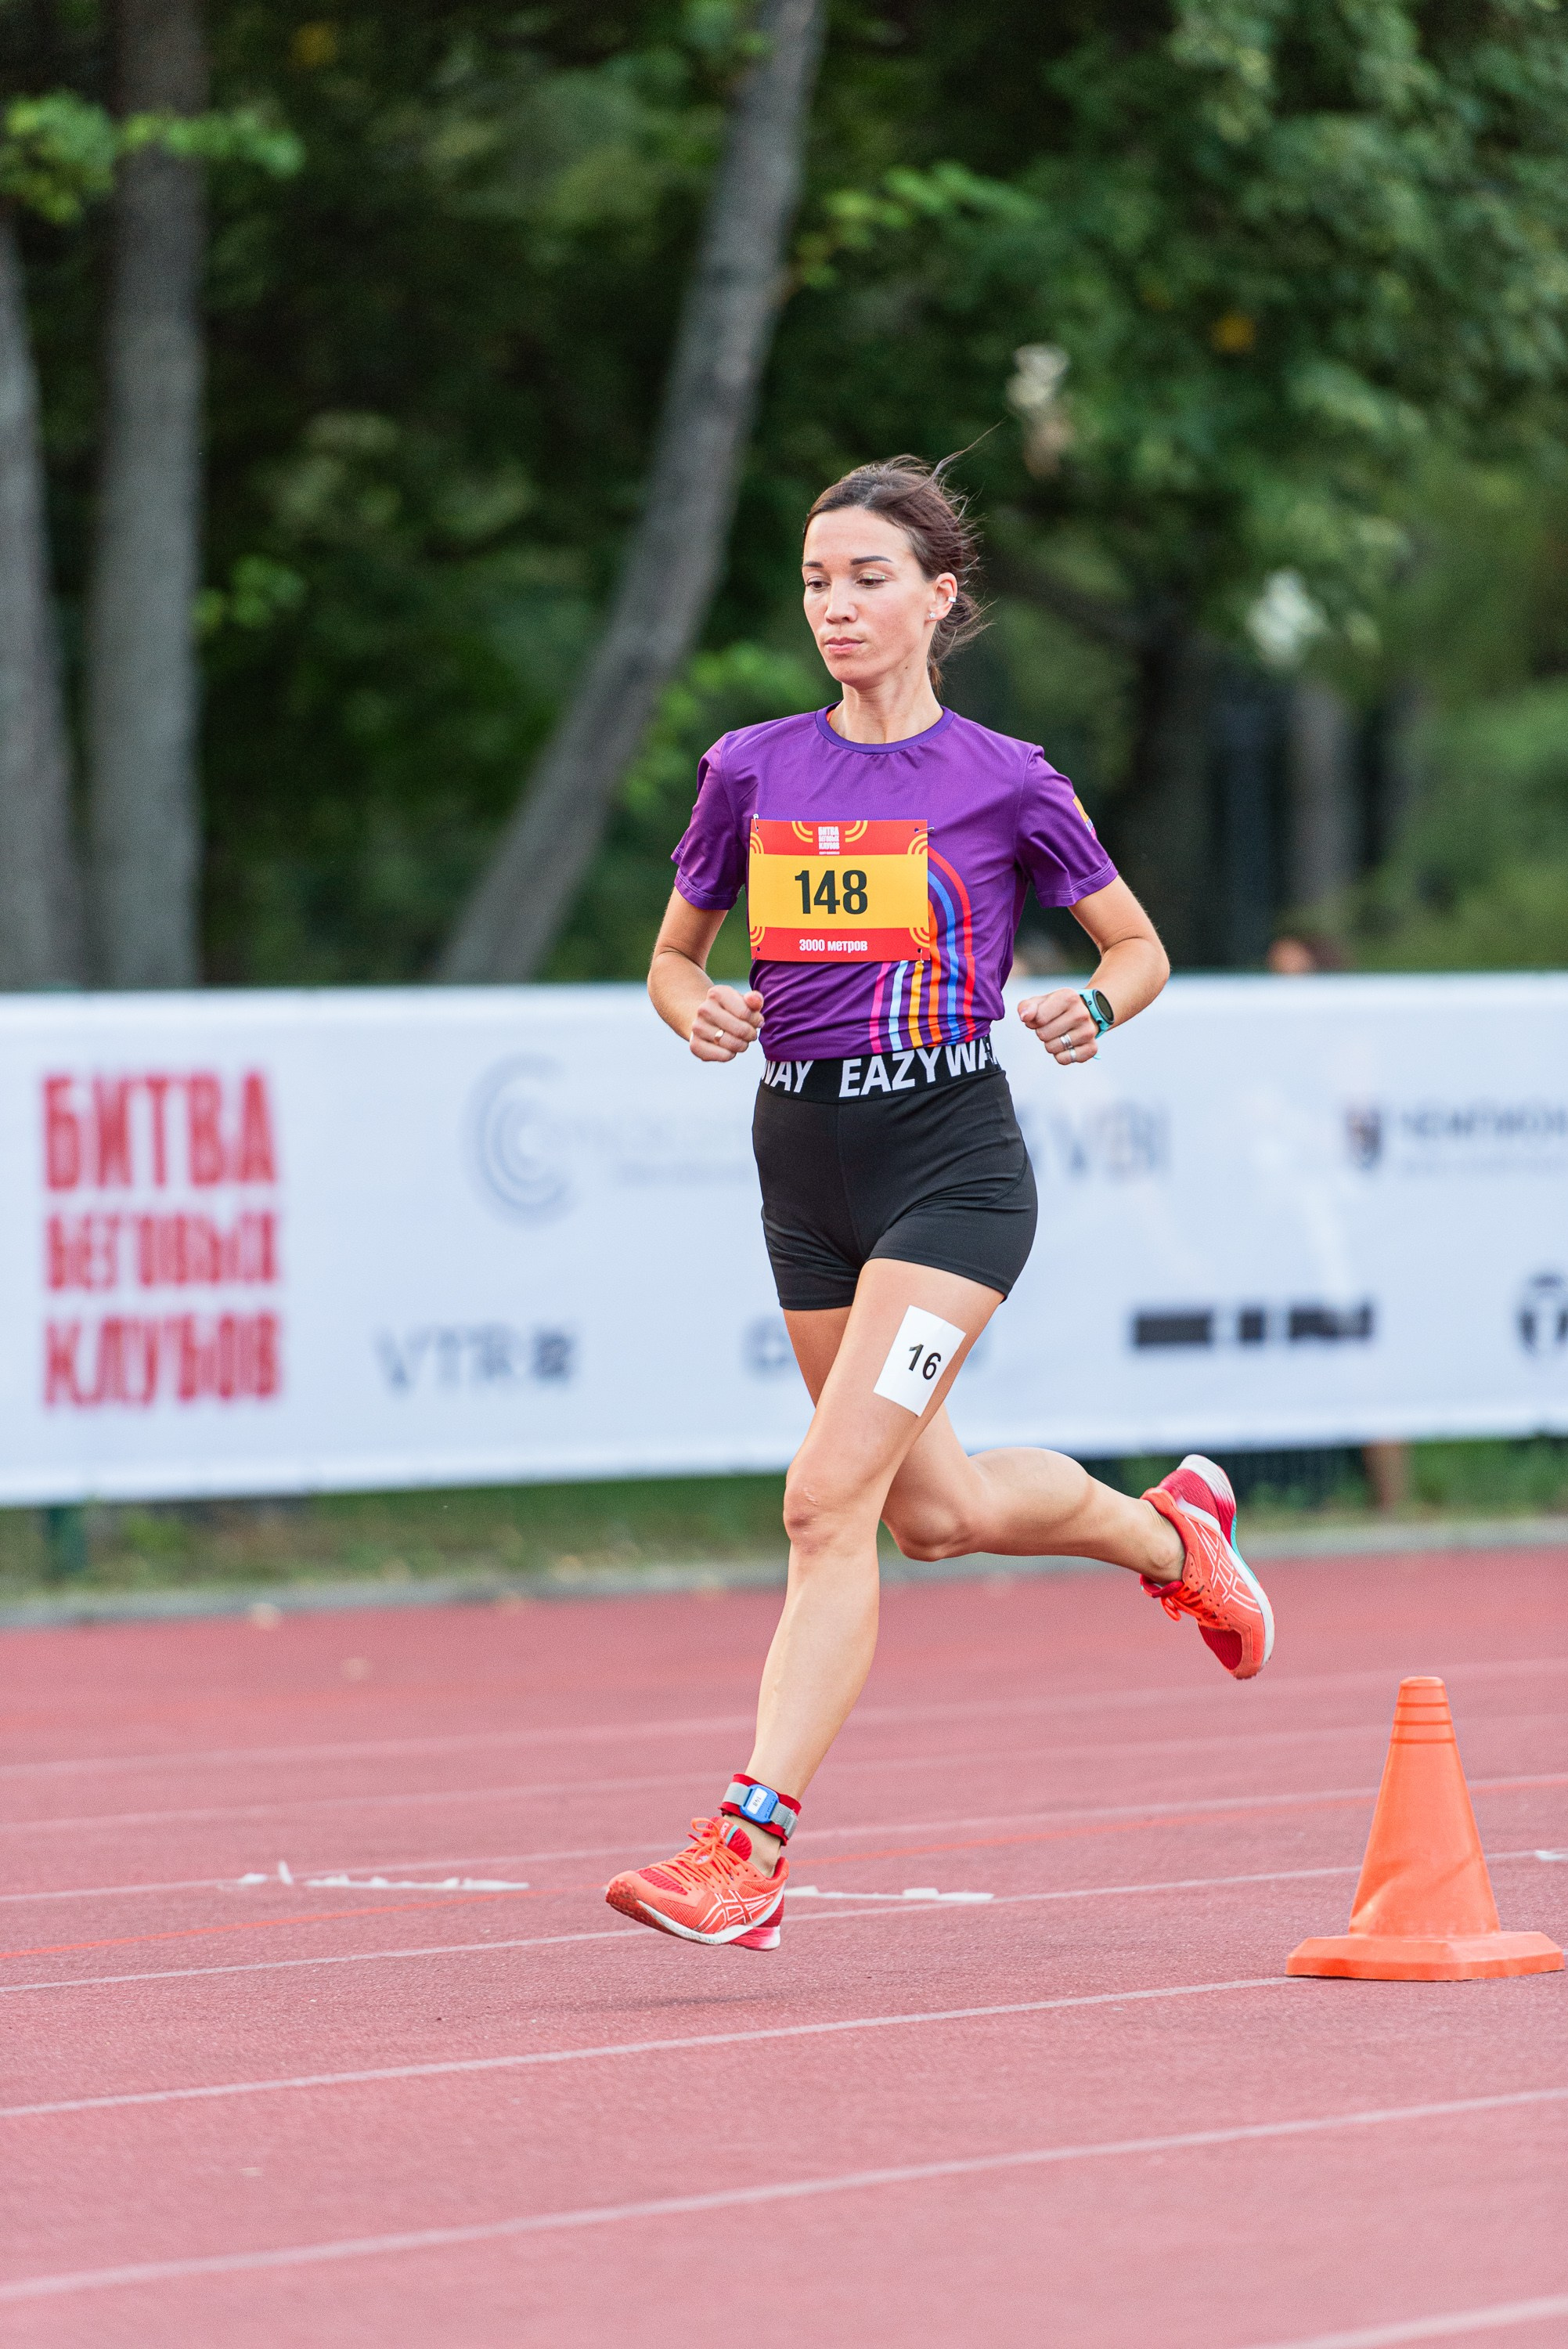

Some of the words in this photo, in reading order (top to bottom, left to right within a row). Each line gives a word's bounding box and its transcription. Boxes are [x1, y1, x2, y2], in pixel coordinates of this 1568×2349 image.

[795, 869, 868, 915] 148
[799, 939, 825, 952] 3000
[827, 940, 867, 954] метров
[42, 1070, 278, 1192] БИТВА
[909, 1344, 942, 1380] 16
